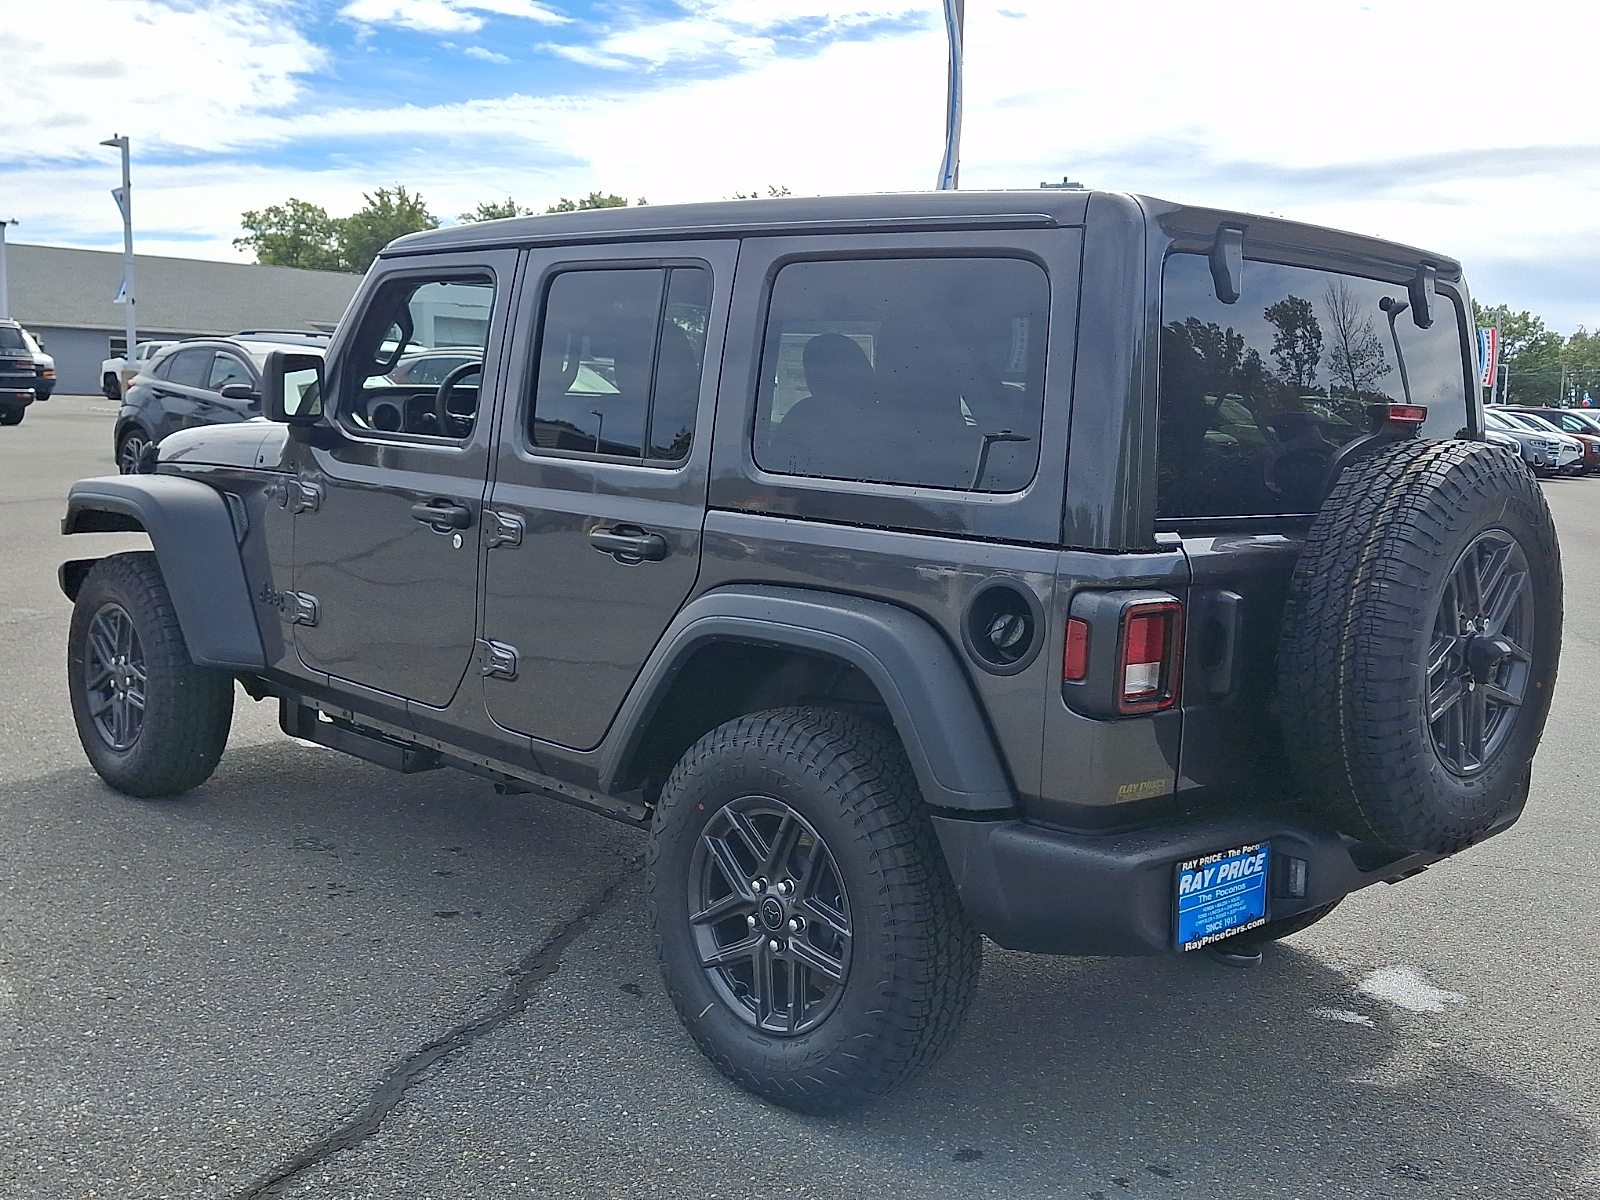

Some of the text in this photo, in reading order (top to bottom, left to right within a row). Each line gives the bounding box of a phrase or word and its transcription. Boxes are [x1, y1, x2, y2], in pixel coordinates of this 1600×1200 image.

[1119, 782, 1139, 794] RAY
[1182, 860, 1198, 871] RAY
[1199, 853, 1222, 866] PRICE
[1228, 849, 1241, 858] The
[1180, 853, 1266, 895] RAY PRICE
[1198, 883, 1246, 903] The Poconos
[1184, 917, 1265, 951] RayPriceCars.com
[1205, 915, 1237, 933] SINCE 1913
